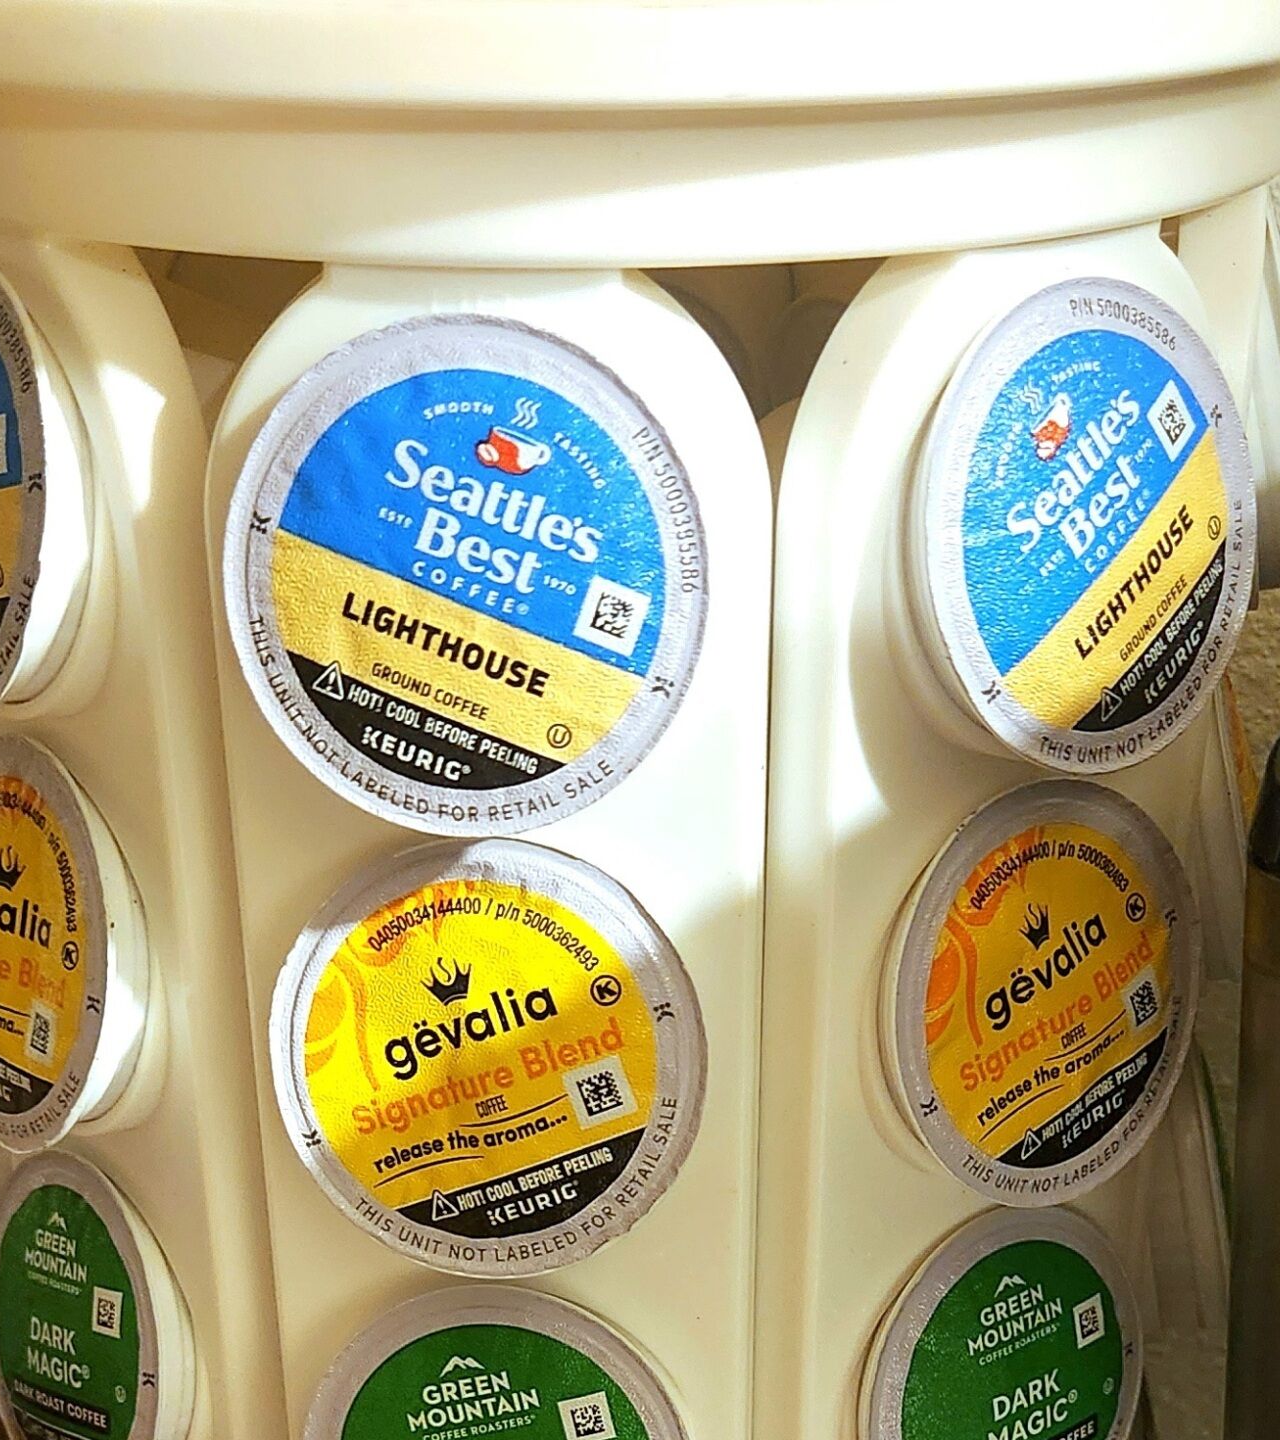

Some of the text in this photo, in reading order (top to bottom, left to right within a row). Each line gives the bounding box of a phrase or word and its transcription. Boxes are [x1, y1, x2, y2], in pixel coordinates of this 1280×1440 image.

[384, 438, 605, 564] Seattle's
[1004, 388, 1142, 554] Seattle's
[655, 465, 701, 594] 5000385586
[1057, 454, 1141, 560] Best
[414, 508, 543, 594] Best
[1073, 503, 1195, 661] LIGHTHOUSE
[341, 591, 550, 698] LIGHTHOUSE
[371, 662, 490, 721] GROUND COFFEE
[523, 908, 600, 972] 5000362493
[958, 930, 1155, 1093] Signature Blend
[352, 1016, 625, 1135] Signature Blend
[476, 1094, 509, 1117] COFFEE
[373, 1114, 568, 1172] release the aroma...
[354, 1096, 679, 1262] THIS UNIT NOT LABELED FOR RETAIL SALE
[24, 1249, 87, 1284] MOUNTAIN
[35, 1228, 77, 1258] GREEN
[967, 1299, 1063, 1356] MOUNTAIN
[980, 1284, 1045, 1327] GREEN
[406, 1389, 541, 1433] MOUNTAIN
[422, 1371, 511, 1405] GREEN
[991, 1369, 1061, 1422] DARK
[470, 1415, 531, 1435] ROASTERS
